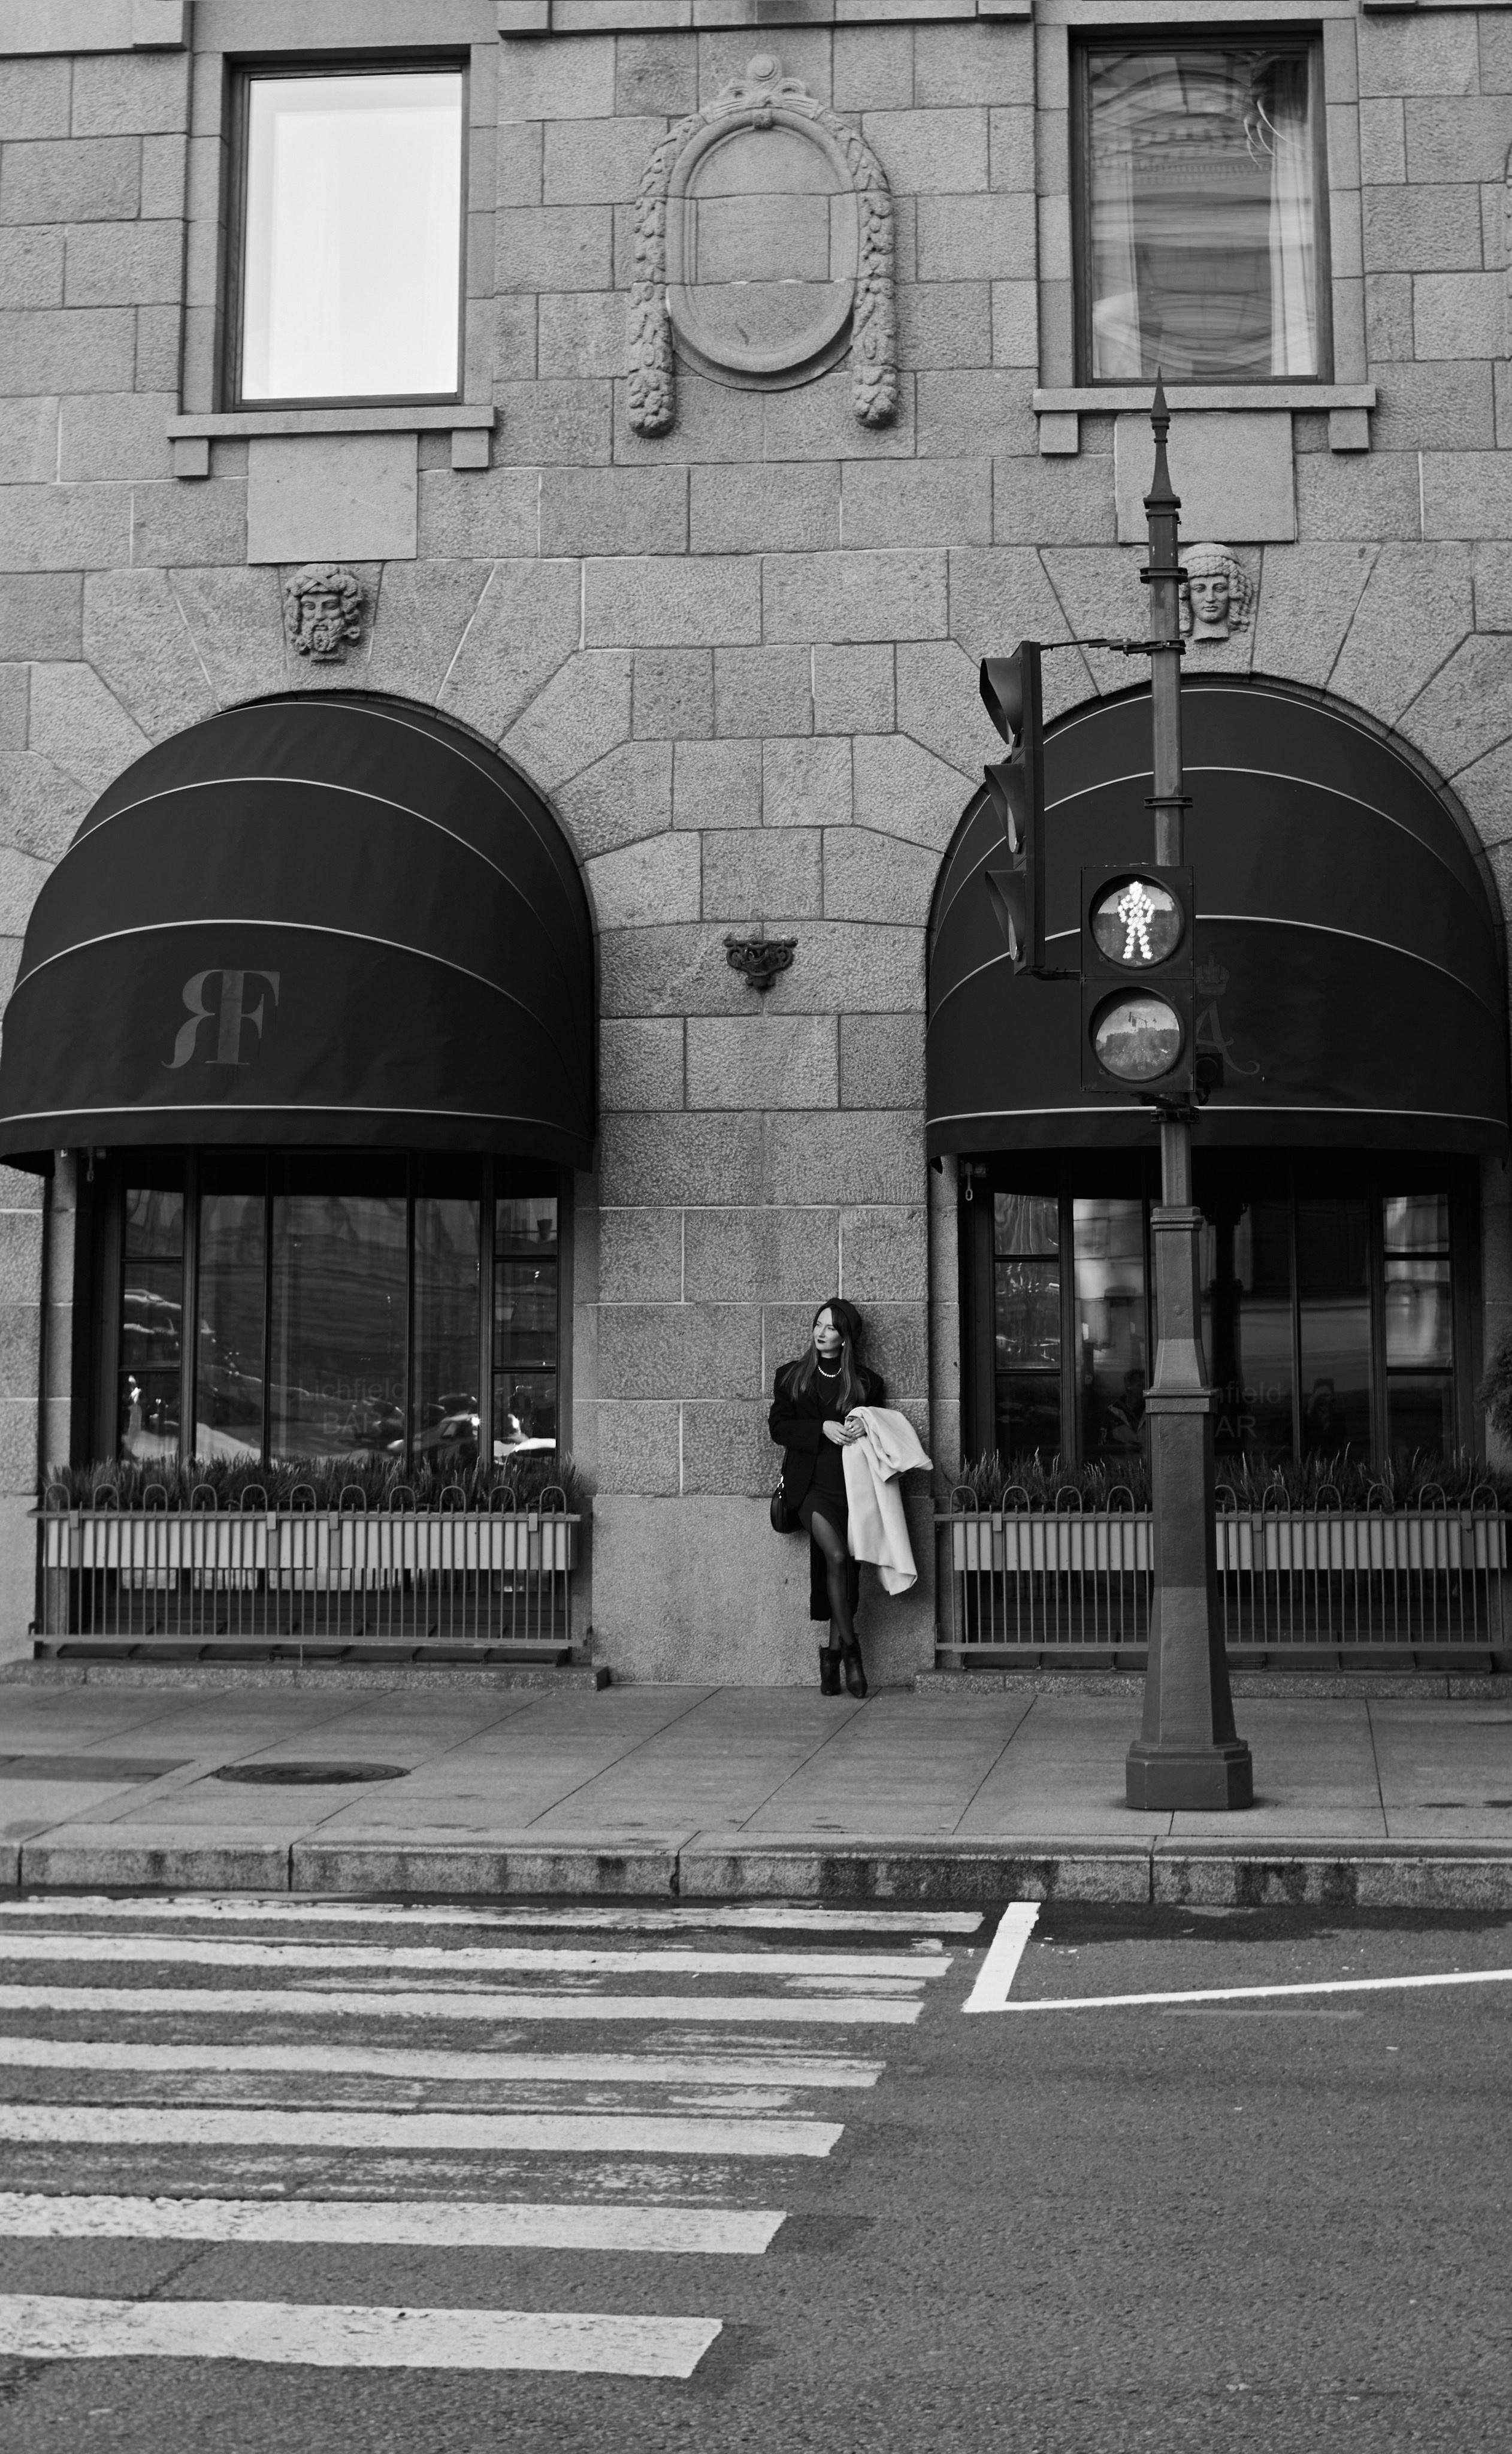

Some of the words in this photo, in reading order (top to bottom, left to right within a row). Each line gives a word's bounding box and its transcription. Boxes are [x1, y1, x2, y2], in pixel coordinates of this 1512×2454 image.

[300, 1377, 406, 1401] Lichfield
[323, 1412, 382, 1434] BAR
[1214, 1415, 1257, 1438] AR
